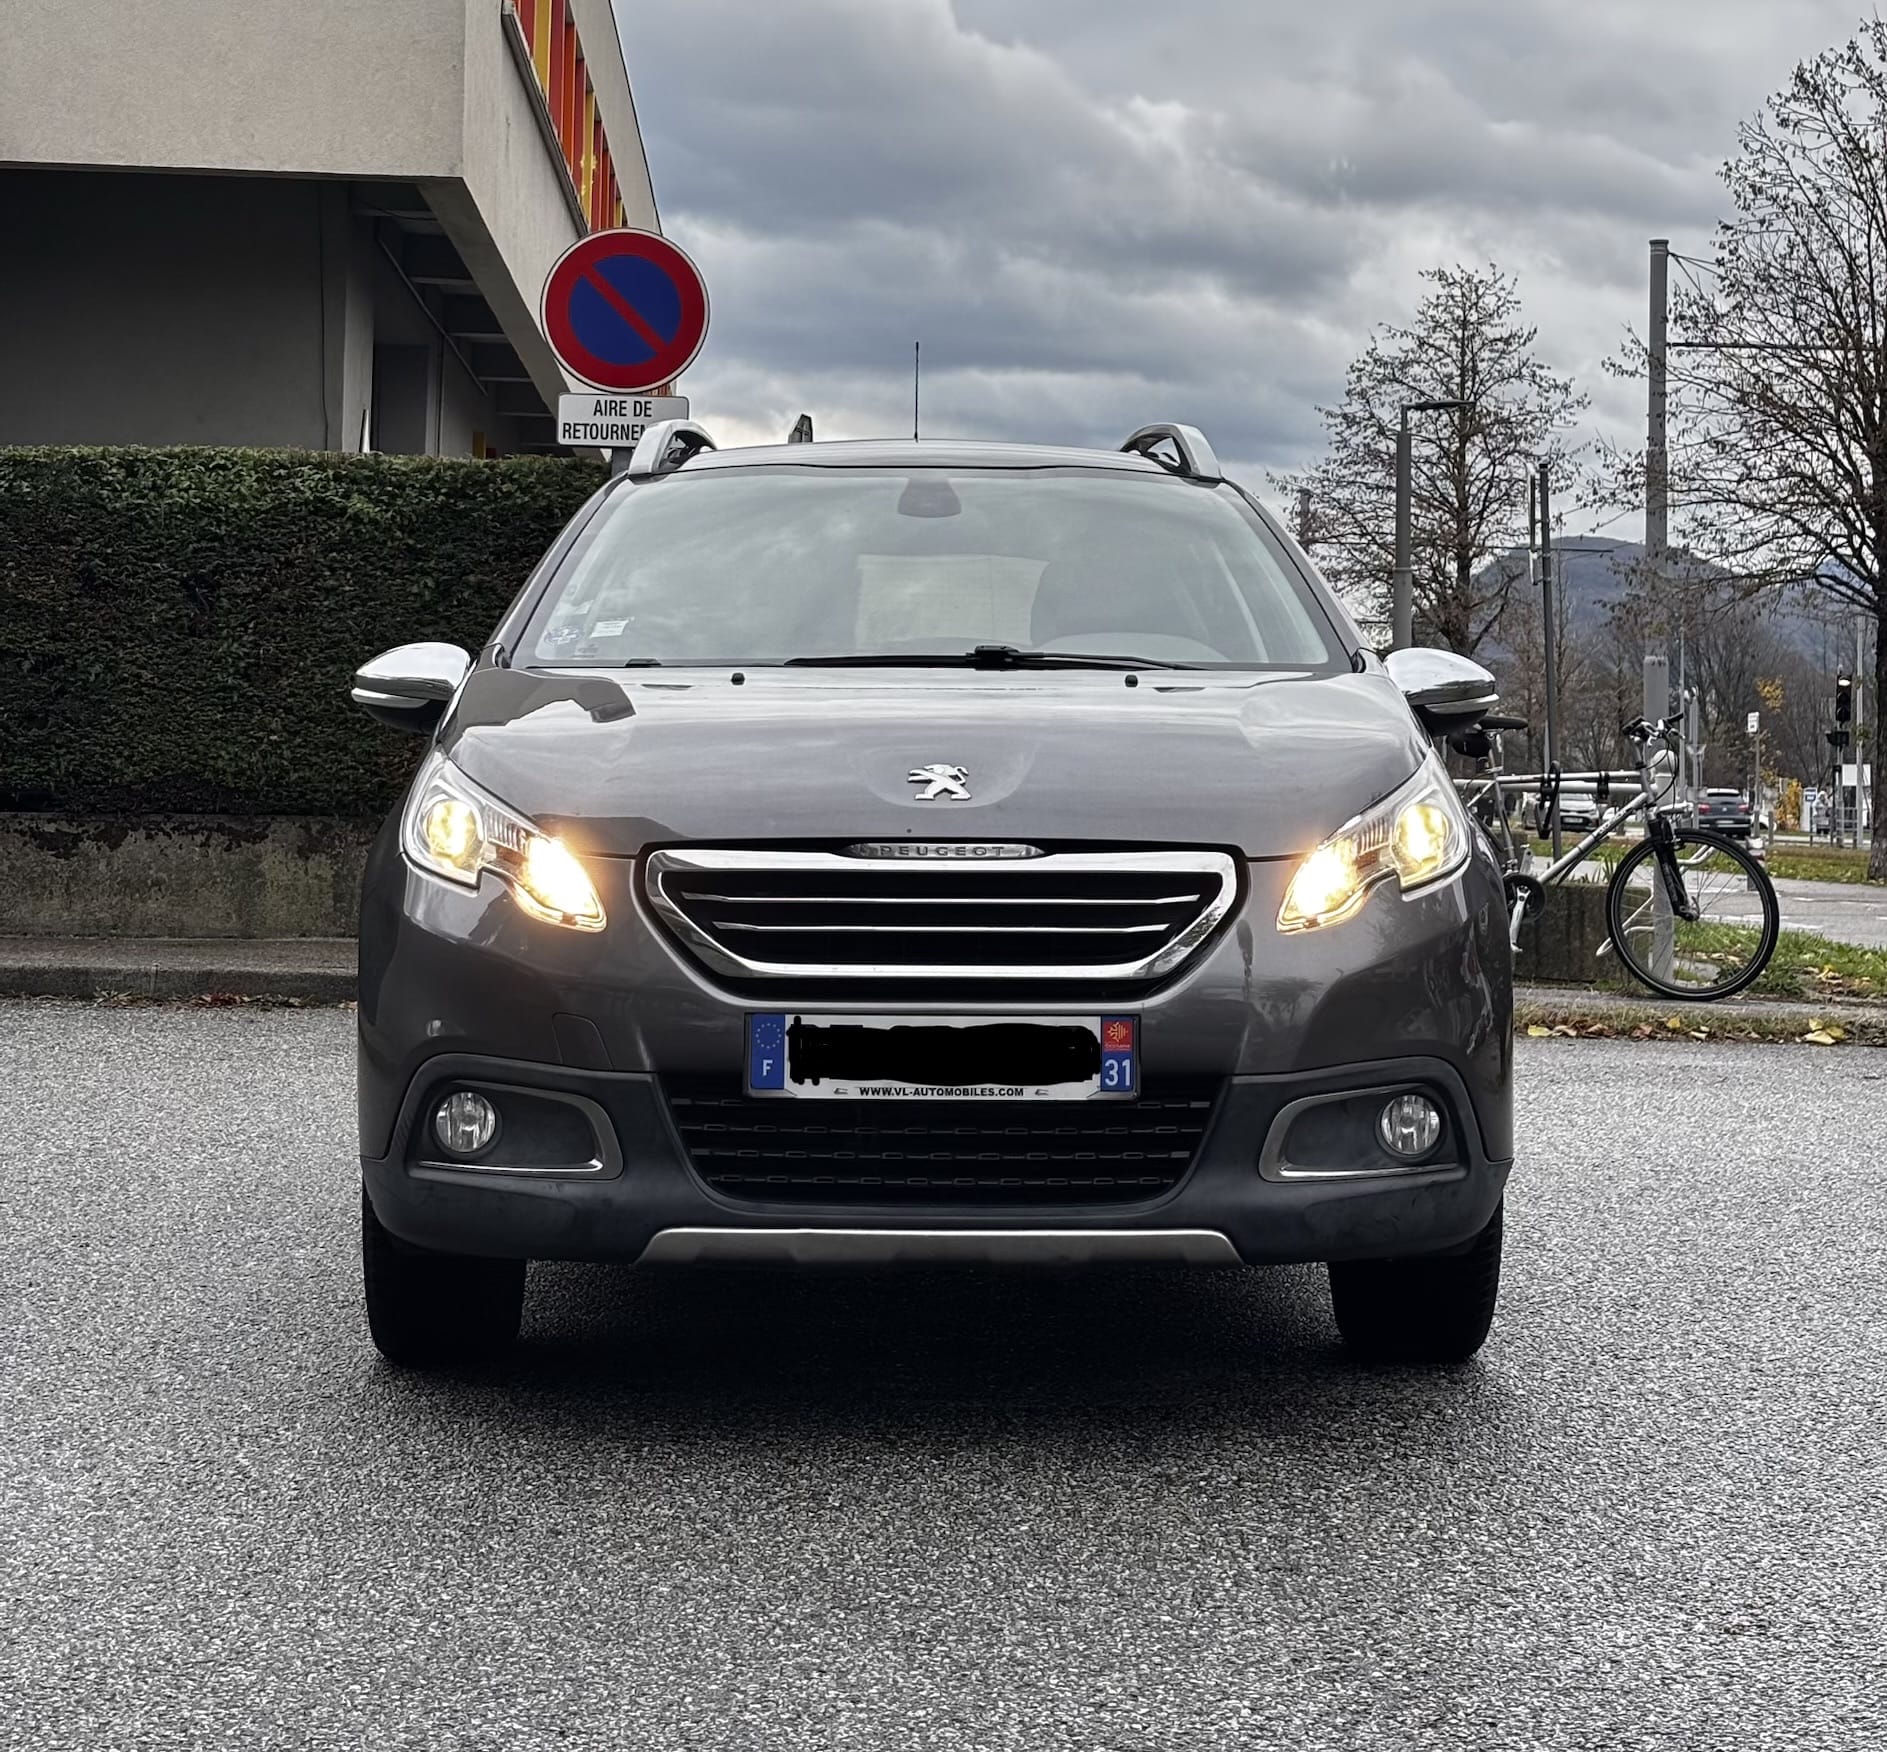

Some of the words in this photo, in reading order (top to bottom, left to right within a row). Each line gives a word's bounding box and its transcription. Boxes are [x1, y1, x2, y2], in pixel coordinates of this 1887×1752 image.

[593, 399, 627, 417] AIRE
[633, 400, 652, 417] DE
[880, 845, 1004, 857] PEUGEOT
[762, 1059, 773, 1076] F
[1105, 1059, 1130, 1087] 31
[859, 1087, 1024, 1097] WWW.VL-AUTOMOBILES.COM
